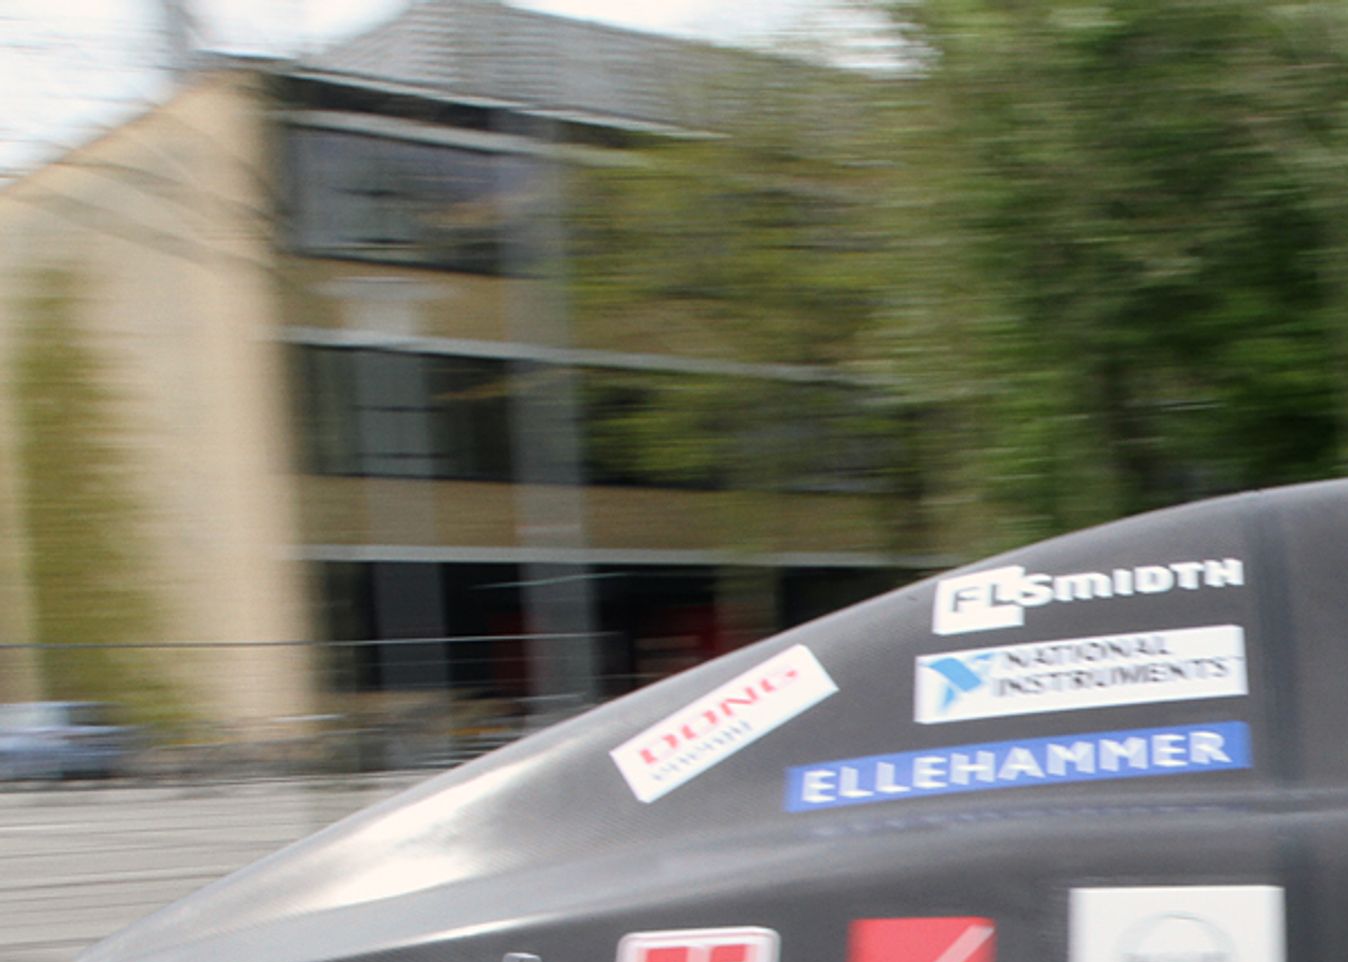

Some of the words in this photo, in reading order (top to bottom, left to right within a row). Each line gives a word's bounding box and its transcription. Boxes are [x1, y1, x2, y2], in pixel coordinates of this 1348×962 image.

[993, 658, 1230, 697] INSTRUMENTS
[1003, 636, 1170, 669] NATIONAL
[640, 669, 798, 765] DONG
[803, 731, 1231, 803] ELLEHAMMER
